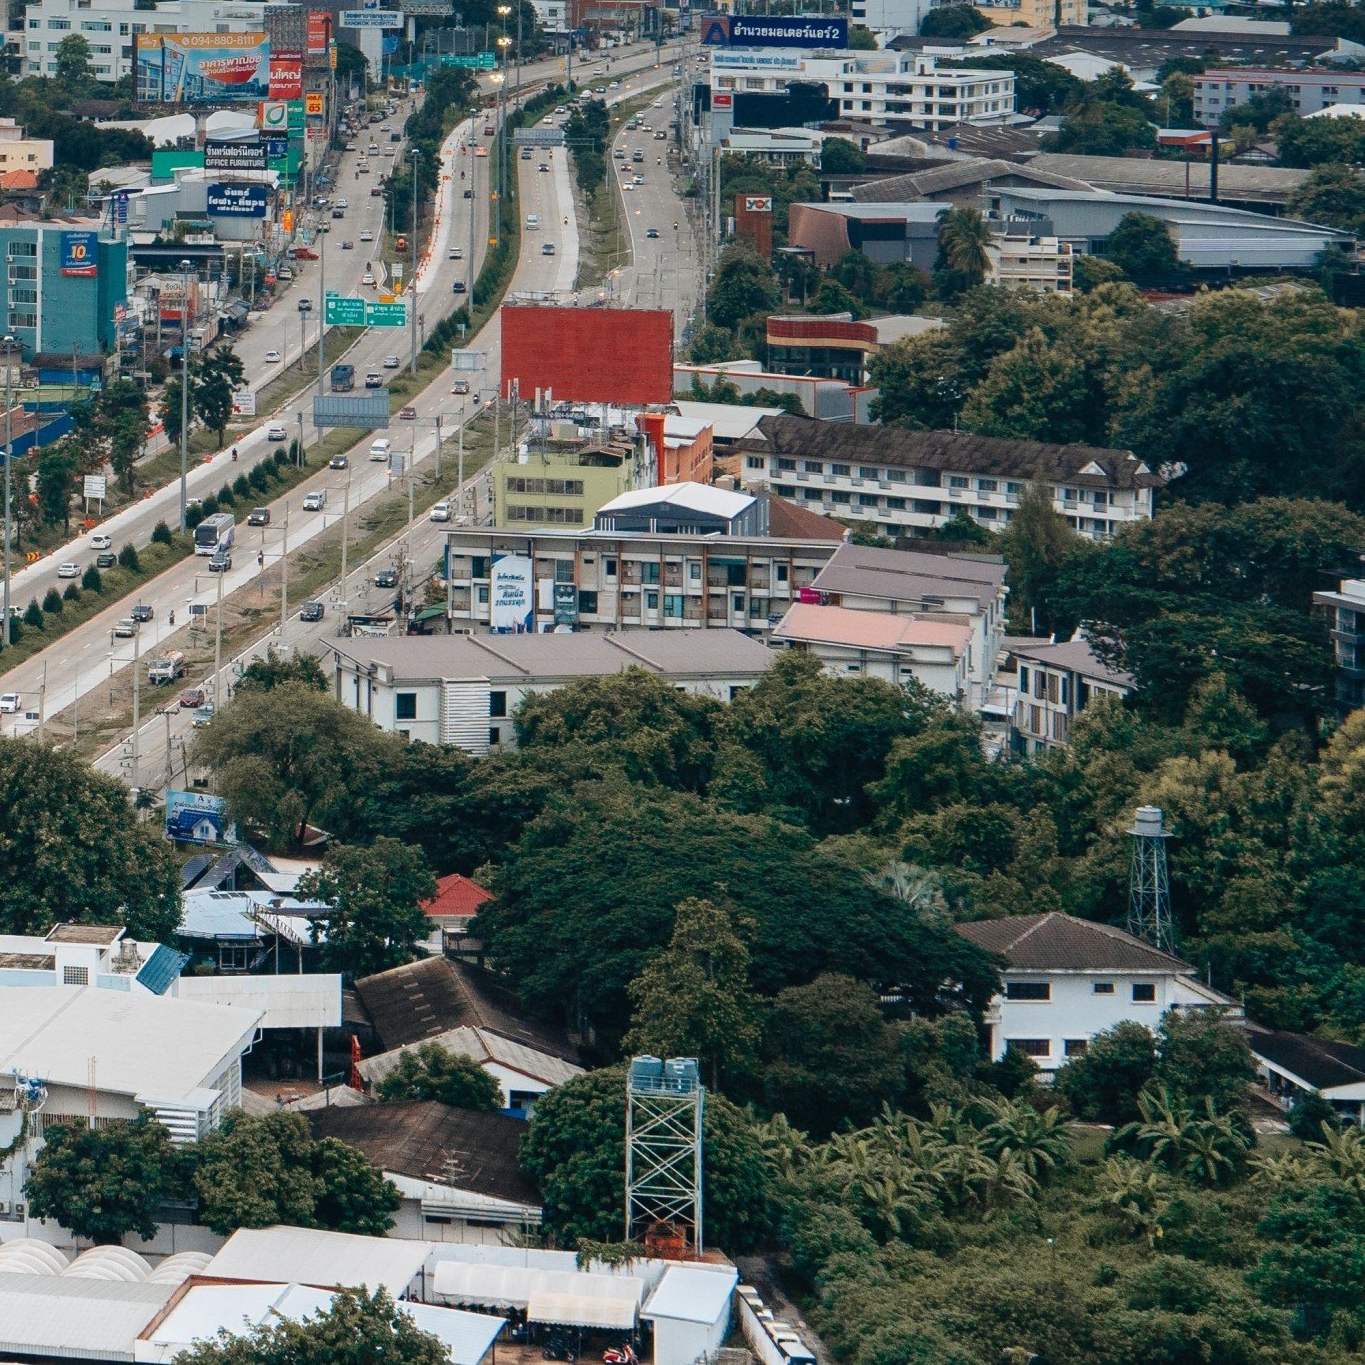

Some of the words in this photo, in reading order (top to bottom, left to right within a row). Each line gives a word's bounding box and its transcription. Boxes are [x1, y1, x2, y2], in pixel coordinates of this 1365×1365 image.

[191, 35, 255, 46] 094-880-8111
[206, 158, 229, 166] OFFICE
[230, 158, 266, 167] FURNITURE
[71, 244, 86, 260] 10
